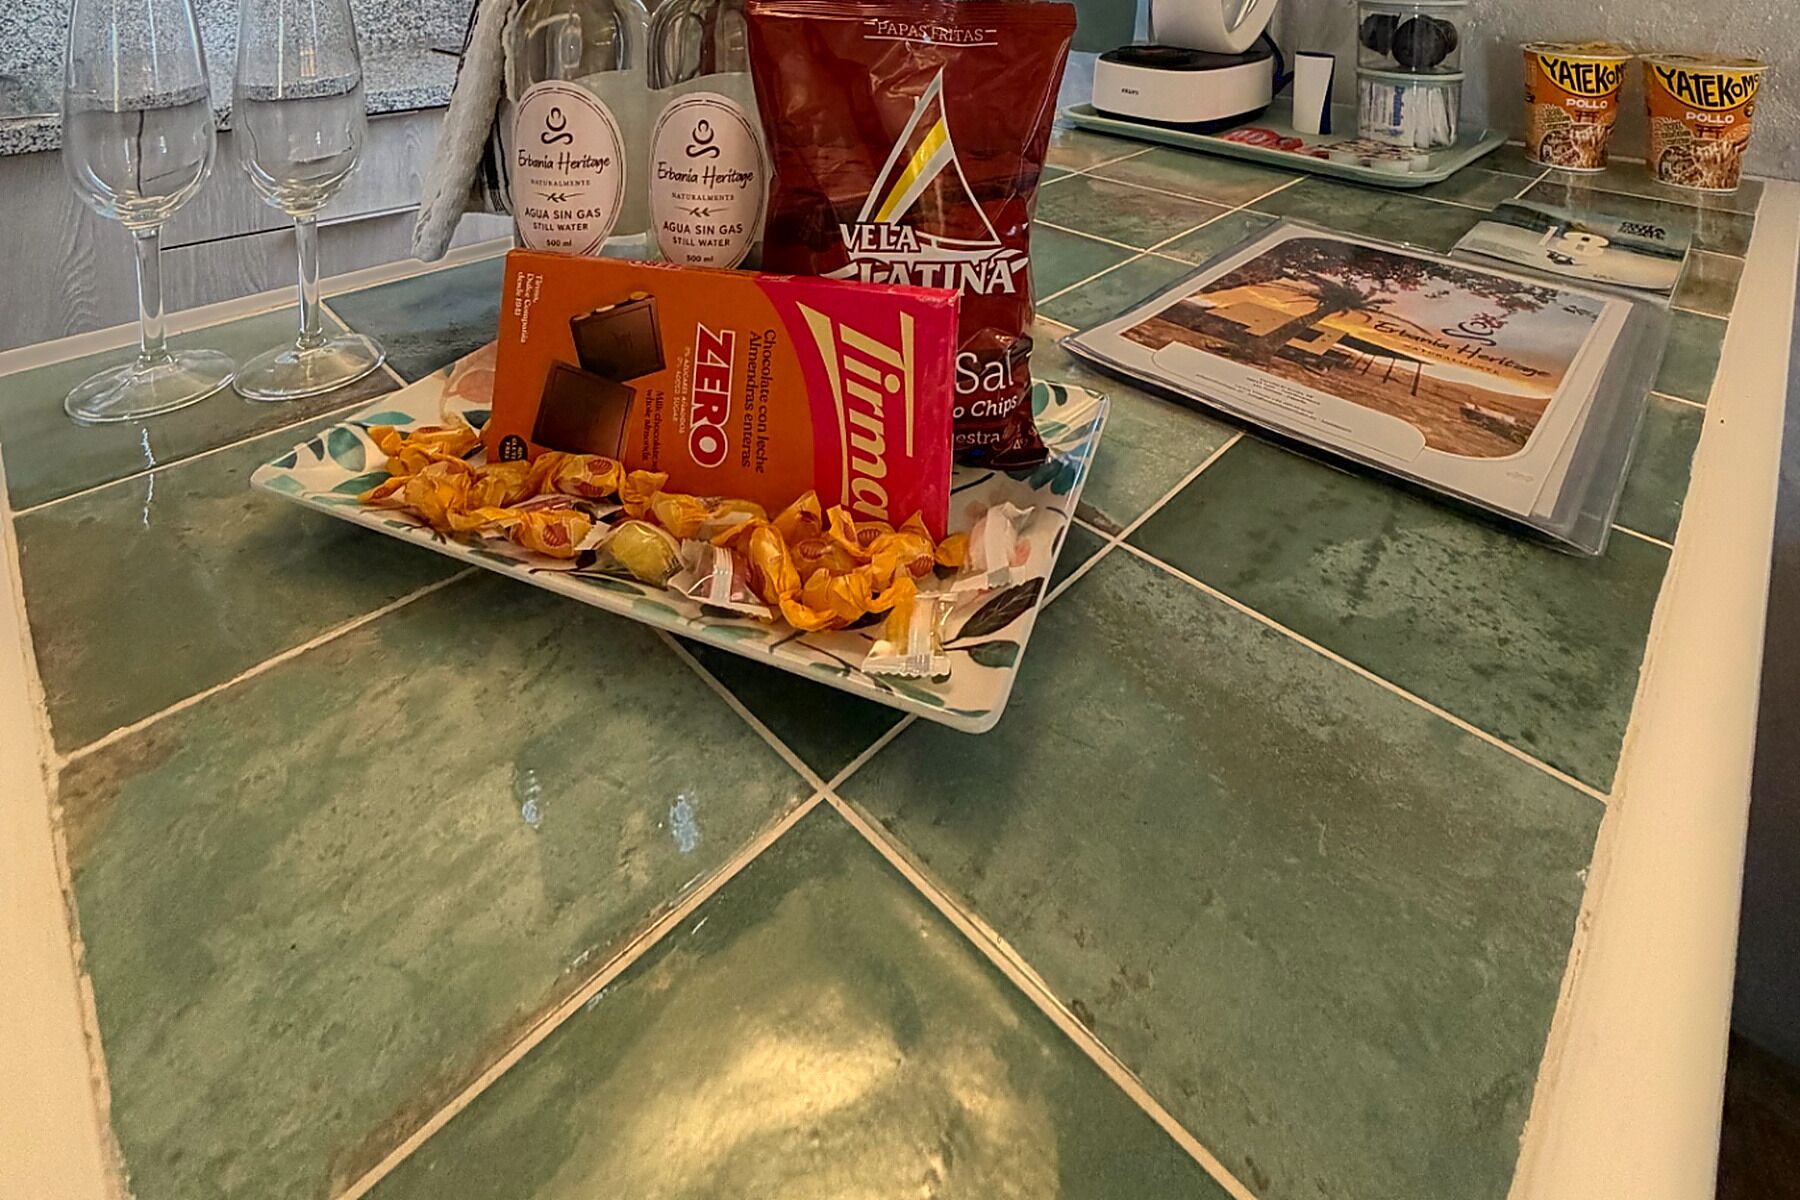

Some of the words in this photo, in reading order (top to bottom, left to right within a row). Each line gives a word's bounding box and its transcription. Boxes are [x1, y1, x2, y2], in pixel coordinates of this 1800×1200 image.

[877, 21, 927, 39] PAPAS
[930, 25, 984, 42] FRITAS
[1540, 55, 1626, 93] YATEKOM
[1655, 65, 1760, 107] YATEKOMO
[1566, 98, 1608, 109] POLLO
[1685, 111, 1735, 124] POLLO
[518, 149, 553, 169] Erbania
[556, 152, 611, 175] Heritage
[657, 162, 698, 183] Erbania
[702, 166, 754, 189] Heritage
[671, 192, 735, 201] NATURALMENTE
[525, 207, 550, 219] AGUA
[553, 209, 573, 220] SIN
[576, 208, 601, 219] GAS
[533, 223, 554, 232] STILL
[557, 223, 589, 232] WATER
[663, 221, 691, 234] AGUA
[695, 223, 715, 235] SIN
[719, 224, 743, 235] GAS
[673, 236, 695, 246] STILL
[698, 238, 730, 246] WATER
[839, 223, 919, 251] VELA
[686, 255, 702, 263] 500
[705, 255, 714, 263] ml
[1374, 320, 1450, 350] Erbania
[1457, 344, 1552, 377] Heritage
[744, 331, 762, 410] Almendras
[758, 329, 777, 403] Chocolate
[955, 349, 1014, 395] Sal
[688, 322, 736, 468] ZERO
[971, 396, 1018, 418] Chips
[757, 405, 768, 432] con
[837, 310, 914, 521] Tirma
[741, 413, 753, 468] enteras
[956, 431, 1000, 445] estra
[755, 435, 769, 474] leche
